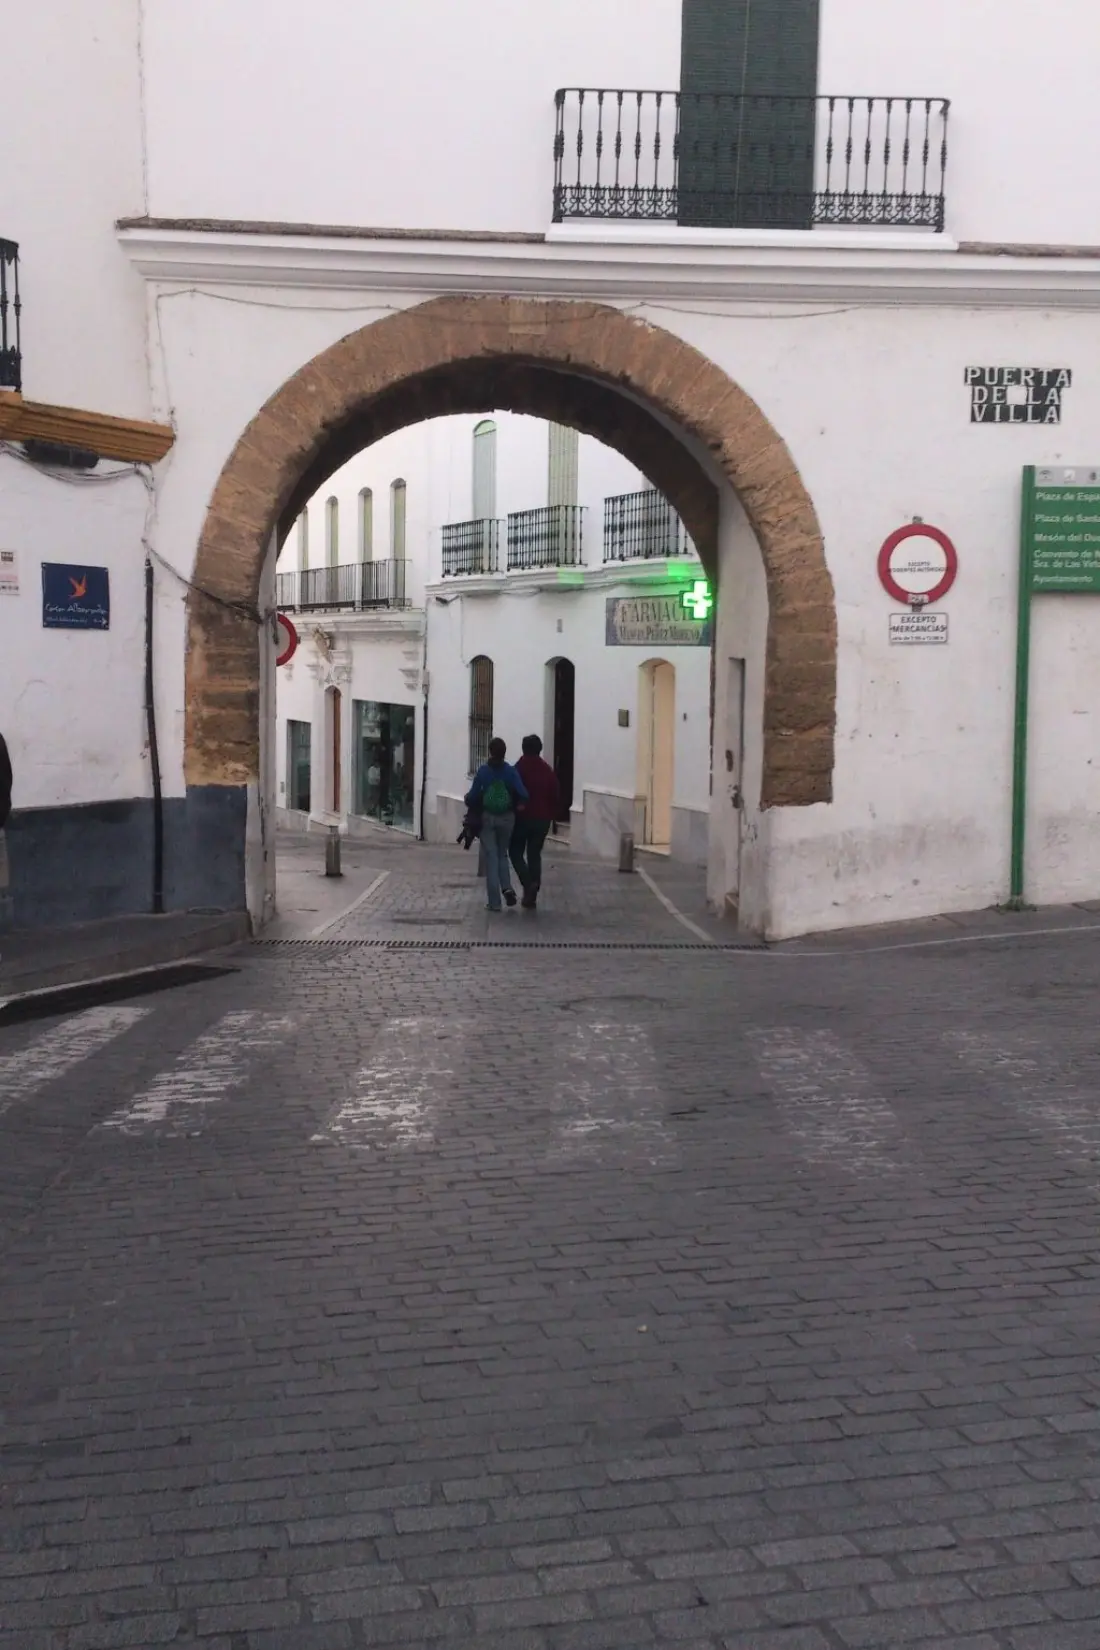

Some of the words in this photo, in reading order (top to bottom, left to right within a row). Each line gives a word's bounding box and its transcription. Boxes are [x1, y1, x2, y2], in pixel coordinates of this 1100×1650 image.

[965, 366, 1071, 387] PUERTA
[973, 385, 1006, 404] DE
[1027, 386, 1060, 405] LA
[971, 404, 1060, 423] VILLA
[900, 616, 937, 624] EXCEPTO
